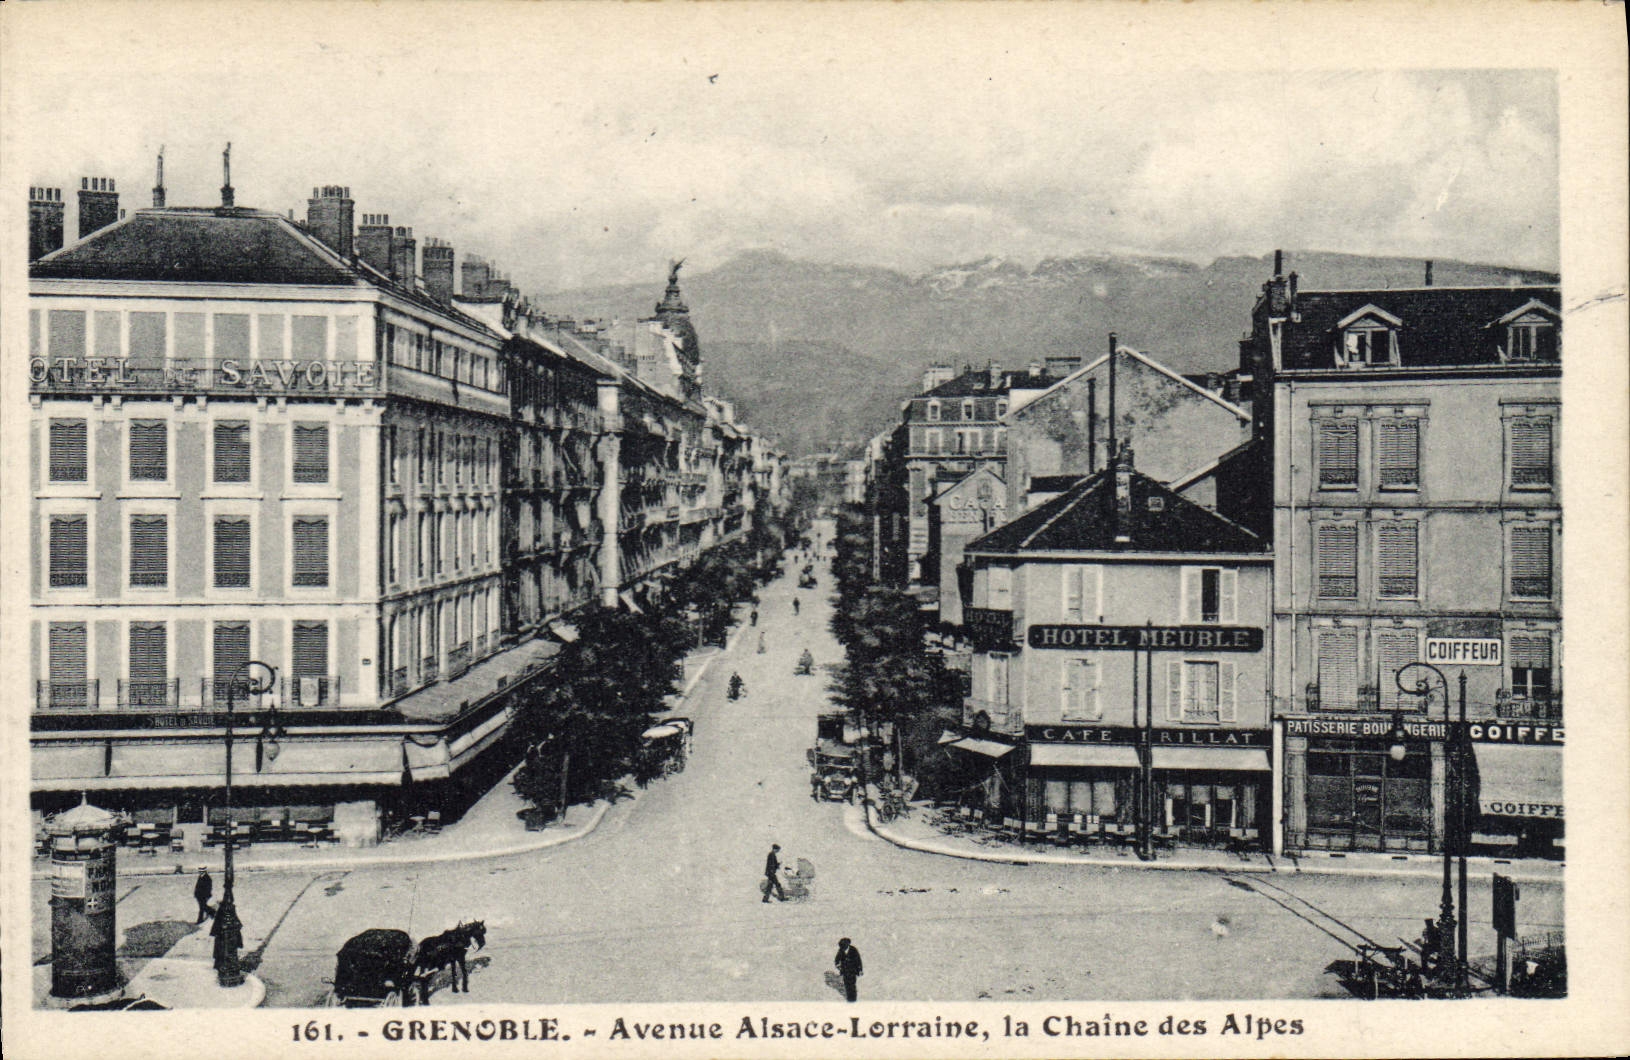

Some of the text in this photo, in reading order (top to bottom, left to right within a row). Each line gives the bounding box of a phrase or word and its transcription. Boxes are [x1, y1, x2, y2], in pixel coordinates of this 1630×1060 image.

[220, 359, 375, 387] SAVOIE
[1041, 628, 1128, 646] HOTEL
[1428, 641, 1499, 660] COIFFEUR
[1043, 729, 1112, 741] CAFE
[1287, 720, 1358, 735] PATISSERIE
[1469, 724, 1564, 741] COIFFE
